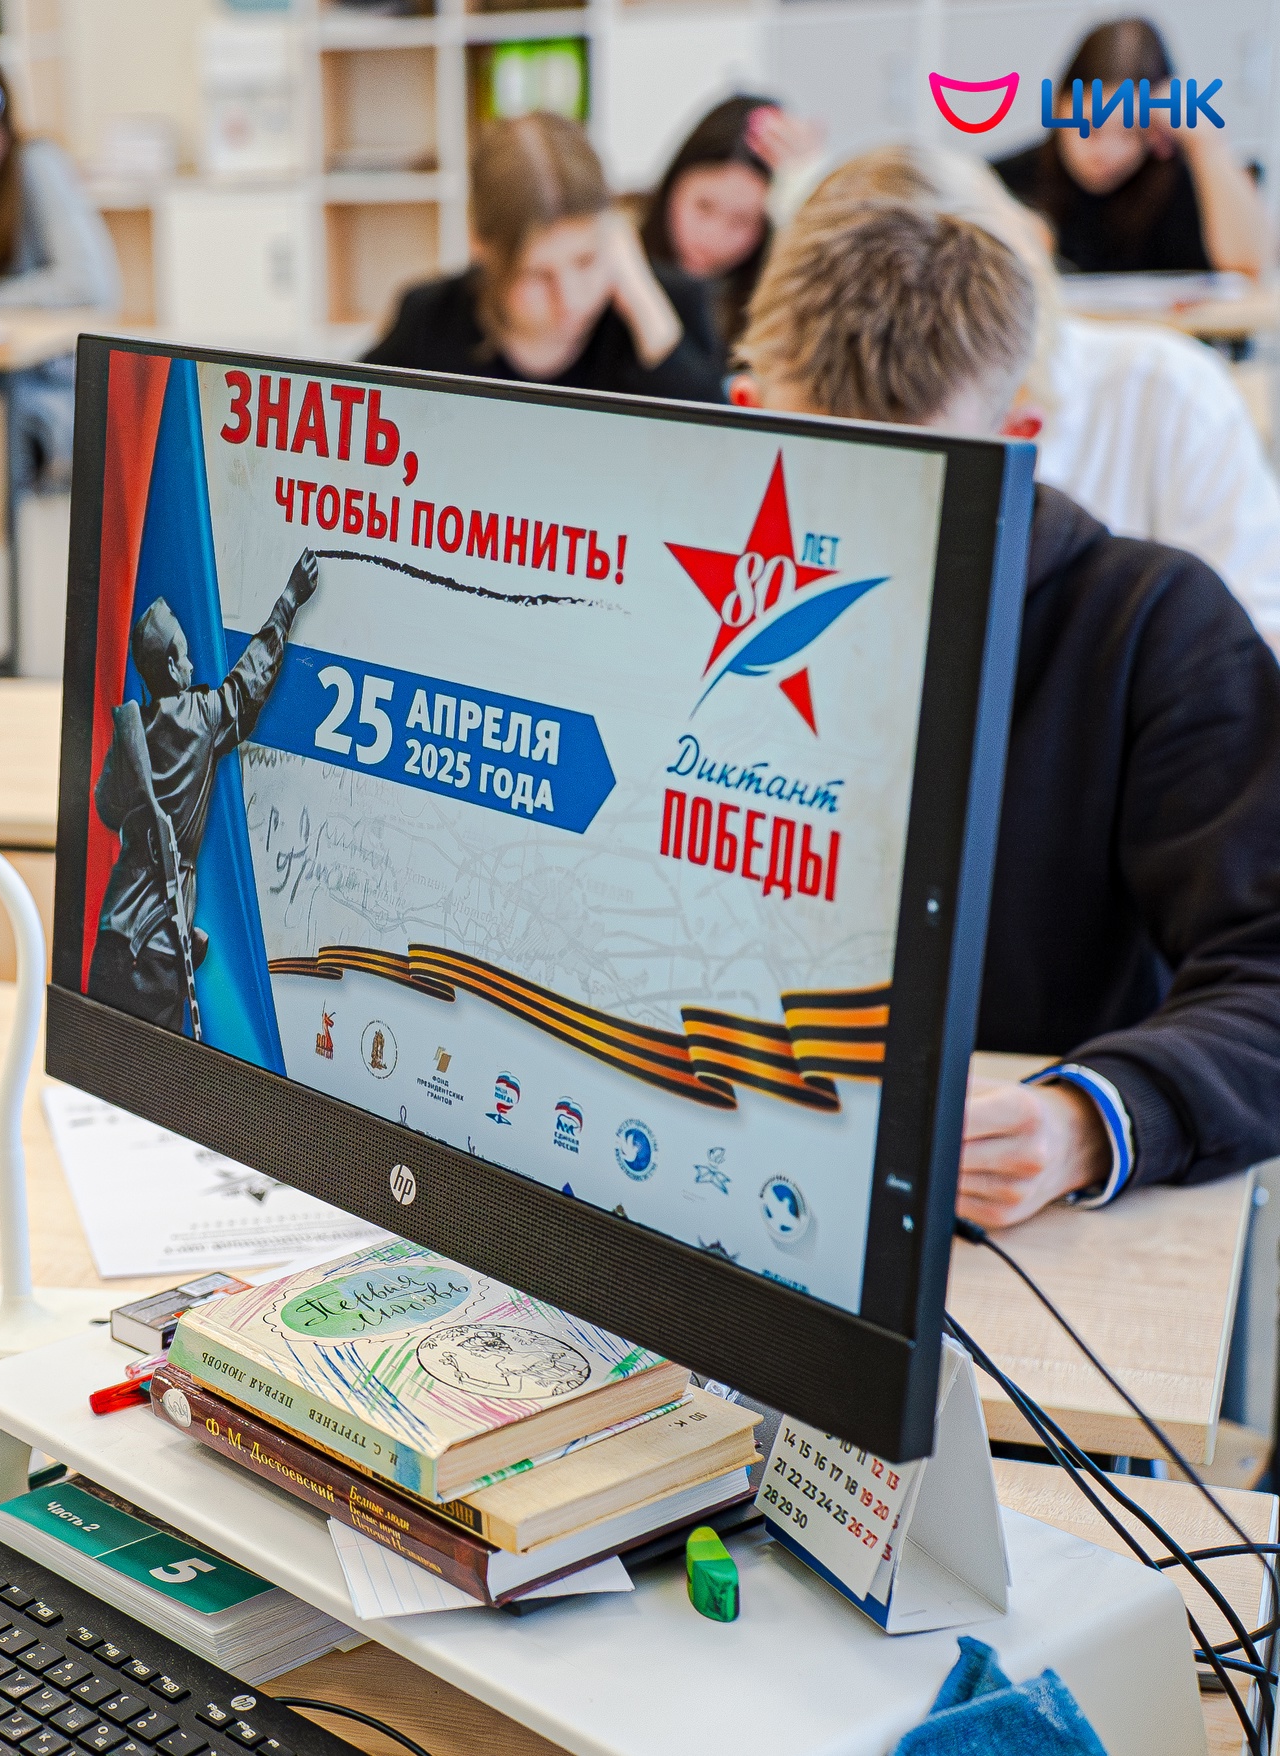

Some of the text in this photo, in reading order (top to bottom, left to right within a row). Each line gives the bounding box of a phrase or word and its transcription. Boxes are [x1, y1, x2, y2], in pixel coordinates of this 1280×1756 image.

[220, 370, 419, 486] ЗНАТЬ,
[275, 476, 628, 586] ЧТОБЫ ПОМНИТЬ!
[801, 532, 840, 567] ЛЕТ
[721, 551, 797, 628] 80
[314, 665, 561, 766] 25 АПРЕЛЯ
[404, 738, 554, 814] 2025 ГОДА
[666, 734, 845, 813] Диктант
[660, 788, 841, 902] ПОБЕДЫ
[427, 1090, 452, 1105] ГРАНТОВ
[432, 1075, 449, 1087] ФОНД
[391, 1164, 414, 1205] hp
[295, 1274, 426, 1327] Первая
[202, 1352, 247, 1383] ЛЮБОВЬ
[249, 1377, 294, 1408] ПЕРВАЯ
[308, 1408, 367, 1448] ТУРГЕНЕВ
[205, 1417, 336, 1504] Ф. М. Достоевский
[782, 1427, 890, 1521] 14 15 16 17 18 19 20
[869, 1457, 885, 1480] 12
[886, 1469, 901, 1491] 13
[47, 1501, 100, 1533] Часть 2
[349, 1485, 385, 1517] Бедные
[384, 1510, 410, 1531] люди
[349, 1500, 379, 1526] Белые
[763, 1483, 809, 1530] 28 29 30
[773, 1456, 879, 1550] 21 22 23 24 25 26 27
[149, 1557, 217, 1584] 5
